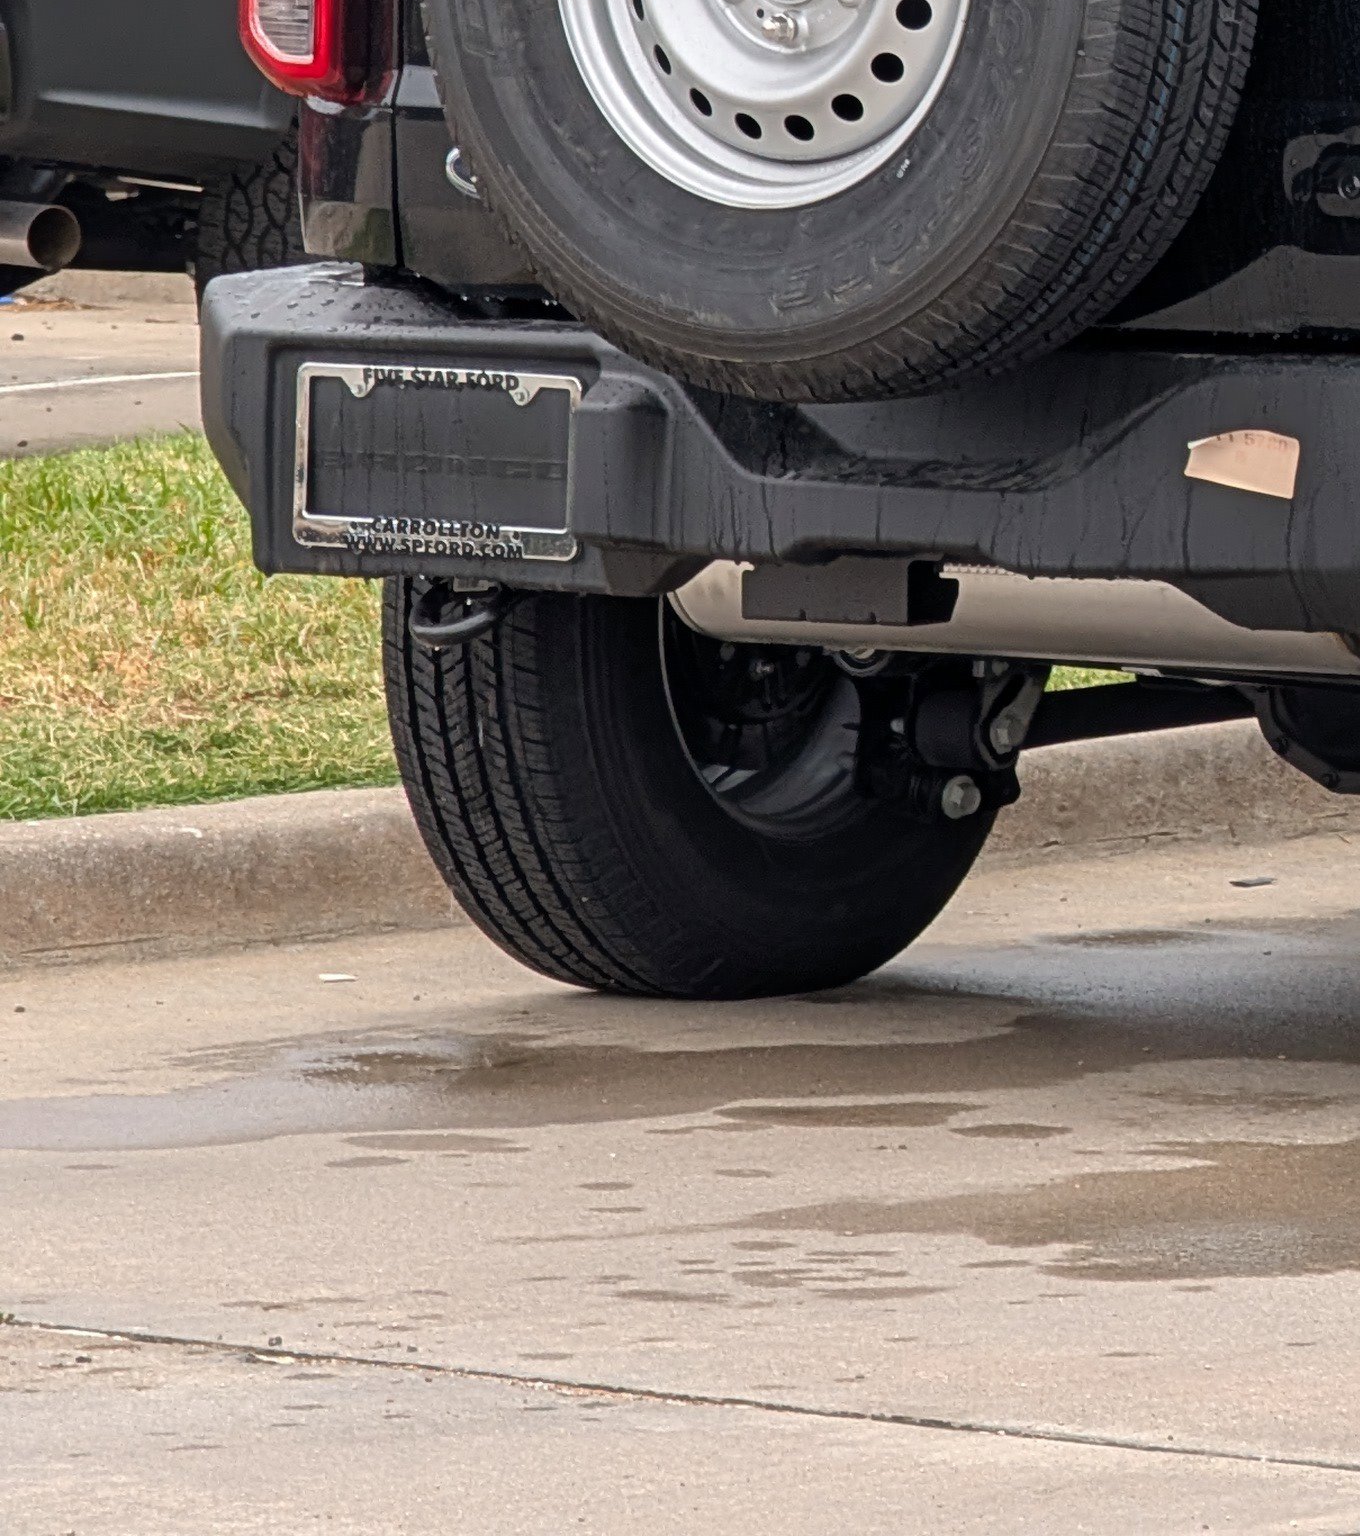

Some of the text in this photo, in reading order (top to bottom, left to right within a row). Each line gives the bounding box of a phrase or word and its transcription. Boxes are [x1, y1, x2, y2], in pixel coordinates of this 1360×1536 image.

[362, 367, 520, 391] FIVE STAR FORD
[371, 517, 501, 540] CARROLLTON
